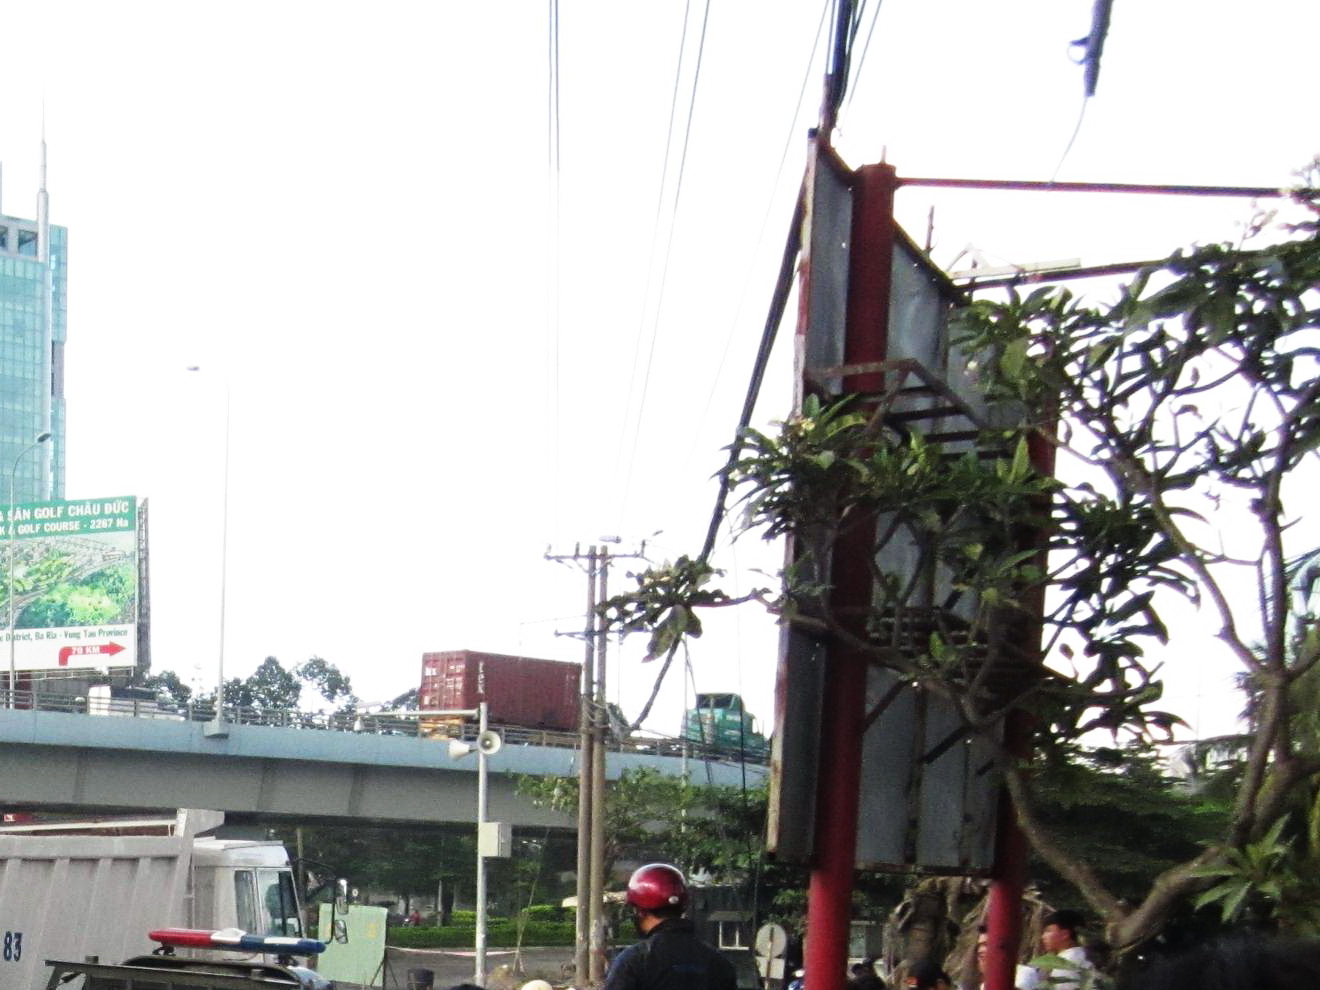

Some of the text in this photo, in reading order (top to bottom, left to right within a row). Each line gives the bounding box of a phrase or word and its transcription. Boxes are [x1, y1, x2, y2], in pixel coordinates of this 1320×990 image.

[34, 506, 64, 519] GOLF
[68, 501, 100, 517] CHÂU
[18, 523, 40, 535] GOLF
[44, 520, 80, 533] COURSE
[86, 645, 101, 654] KM
